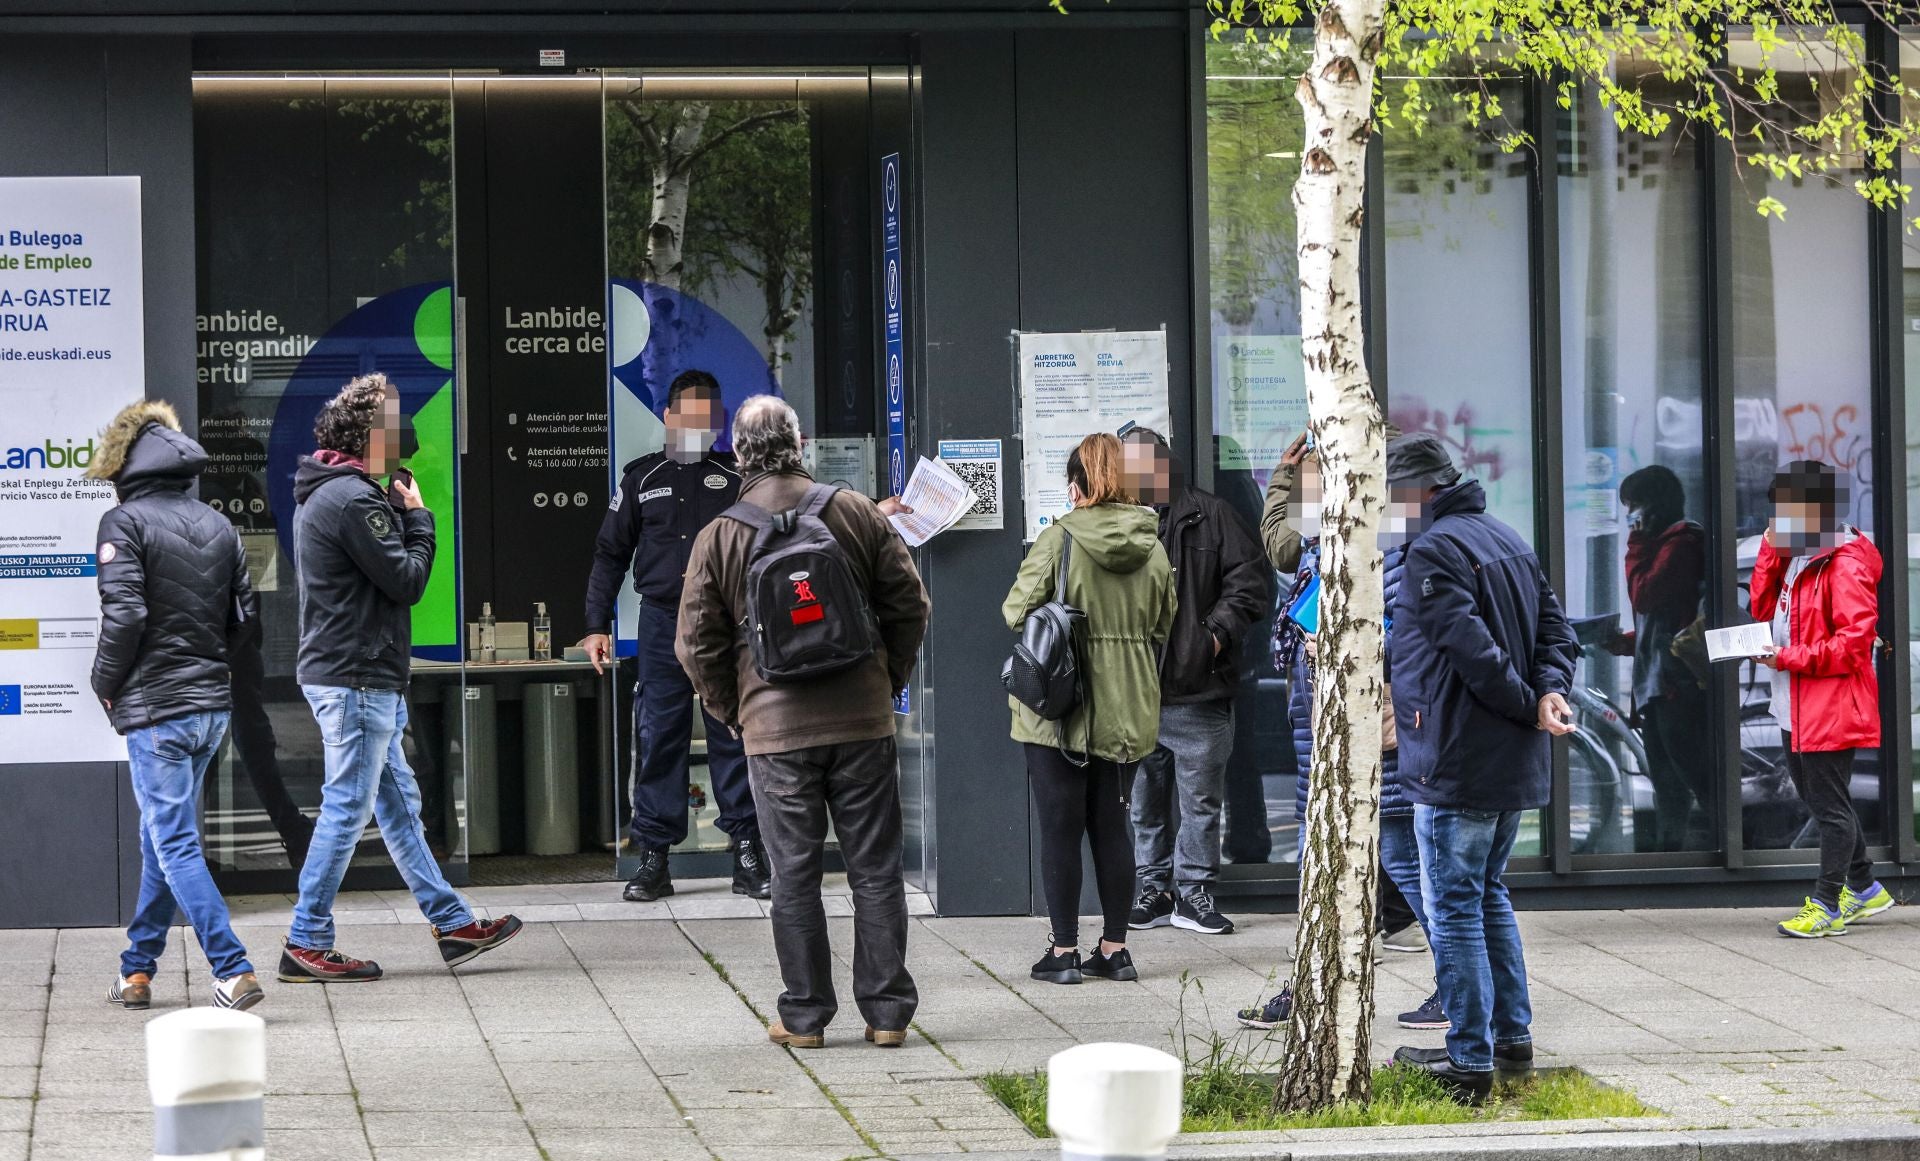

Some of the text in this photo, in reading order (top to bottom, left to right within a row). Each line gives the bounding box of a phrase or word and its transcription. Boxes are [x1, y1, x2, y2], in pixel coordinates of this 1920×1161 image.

[10, 231, 83, 249] Bulegoa
[0, 253, 92, 272] de Empleo
[0, 289, 111, 307] A-GASTEIZ
[0, 314, 48, 332] RUA
[195, 310, 285, 335] anbide,
[505, 307, 607, 331] Lanbide,
[505, 332, 605, 353] cerca de
[0, 347, 112, 361] ide.euskadi.eus
[197, 363, 247, 383] ertu
[241, 417, 273, 427] bidezk
[527, 412, 567, 421] Atención
[568, 413, 584, 423] por
[0, 438, 97, 469] anbid
[527, 445, 608, 456] Atención telefónic
[527, 459, 543, 468] 945
[545, 459, 560, 467] 160
[561, 459, 577, 467] 600
[584, 459, 599, 467] 630
[25, 479, 64, 490] Enplegu
[66, 478, 114, 488] Zerbitzua
[29, 491, 58, 500] Vasco
[60, 491, 72, 500] de
[75, 490, 112, 501] Empleo
[648, 489, 671, 497] DELTA
[0, 555, 88, 566] USKO JAURLARITZA
[50, 567, 81, 576] VASCO
